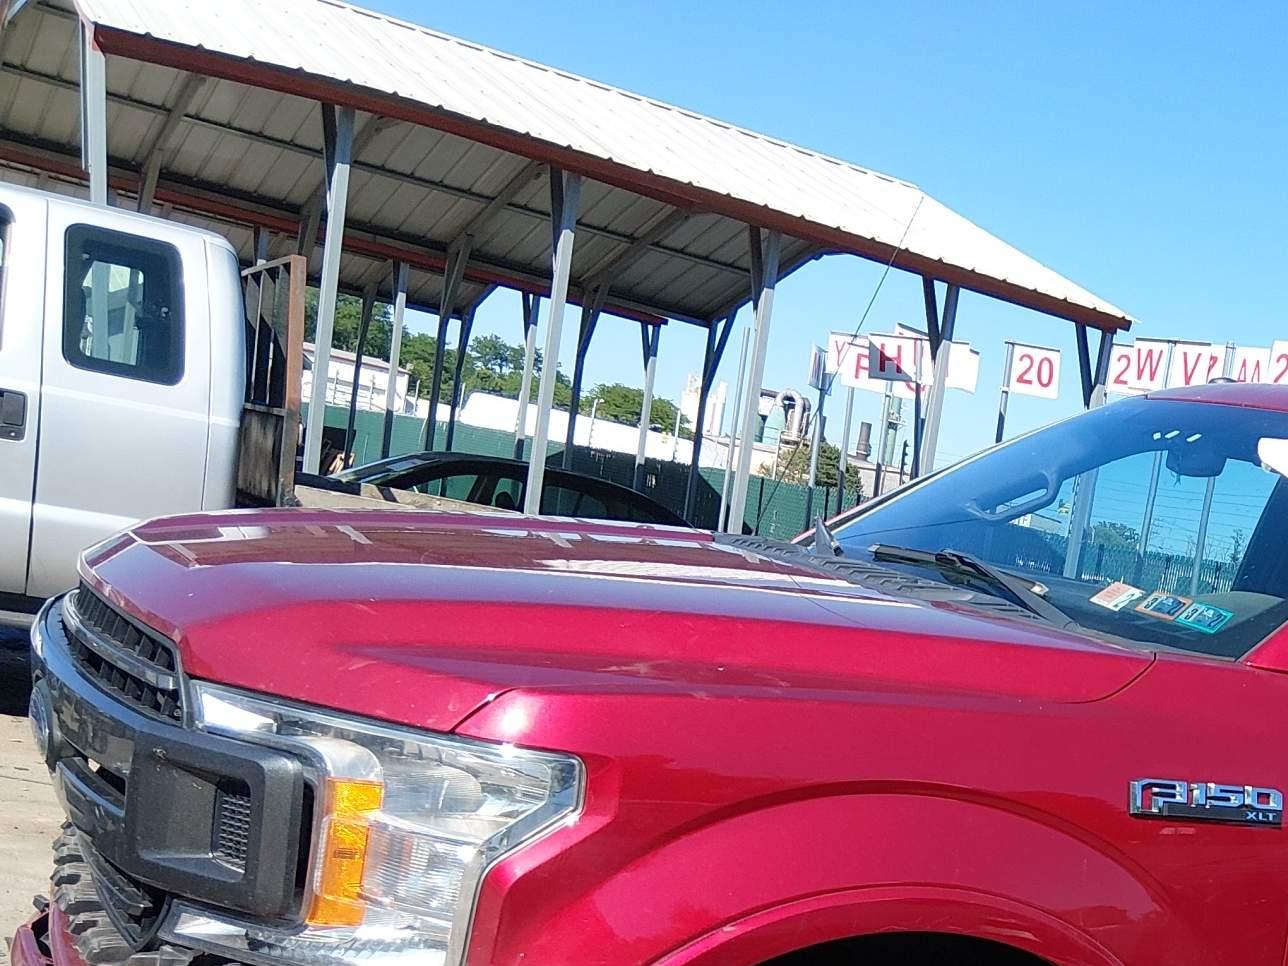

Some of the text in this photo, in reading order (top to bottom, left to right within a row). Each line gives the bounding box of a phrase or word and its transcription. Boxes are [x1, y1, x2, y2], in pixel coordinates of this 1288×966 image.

[879, 343, 902, 374] H
[1016, 353, 1054, 388] 20
[1246, 811, 1277, 821] XLT
